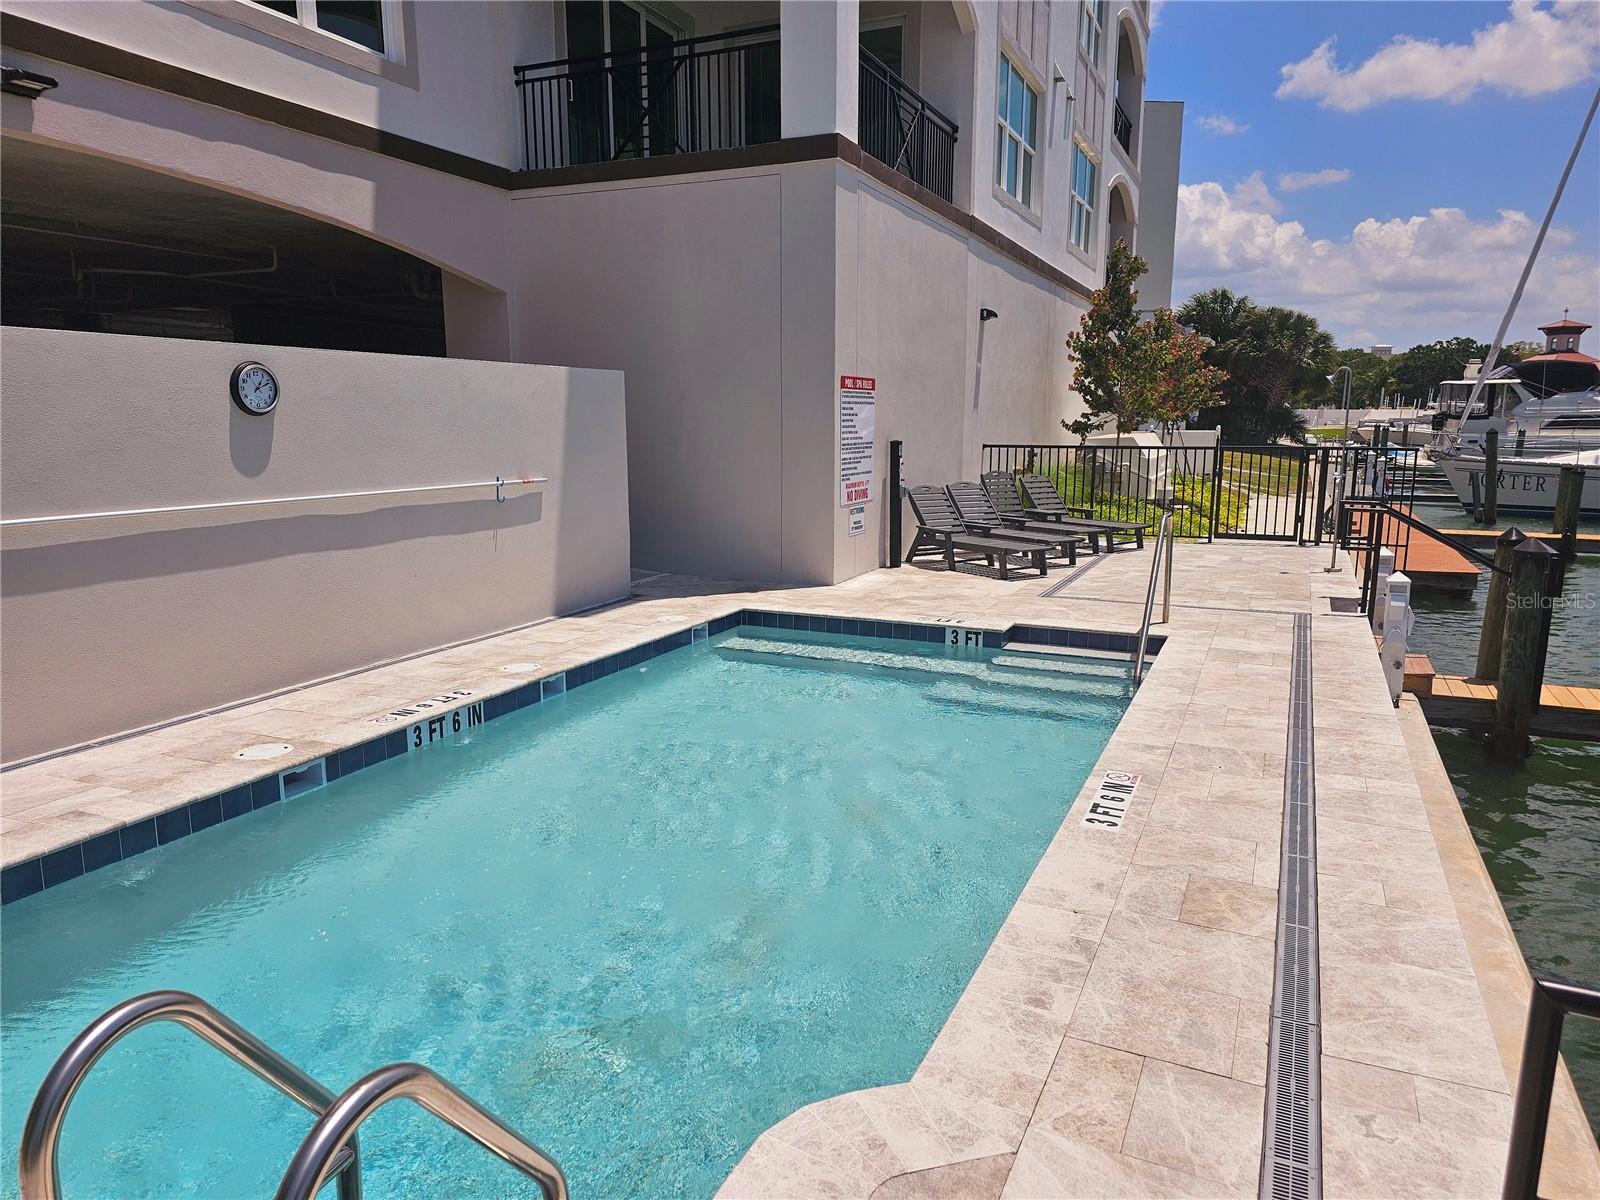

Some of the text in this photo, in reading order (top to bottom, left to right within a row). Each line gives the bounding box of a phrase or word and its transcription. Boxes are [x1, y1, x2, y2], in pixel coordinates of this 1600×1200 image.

[844, 378, 854, 388] POOL
[1468, 471, 1546, 492] ORTER
[846, 487, 869, 502] NO DIVING
[951, 629, 982, 647] 3 FT
[413, 702, 483, 748] 3 FT 6 IN
[1085, 781, 1135, 827] 3 FT 6 IN
